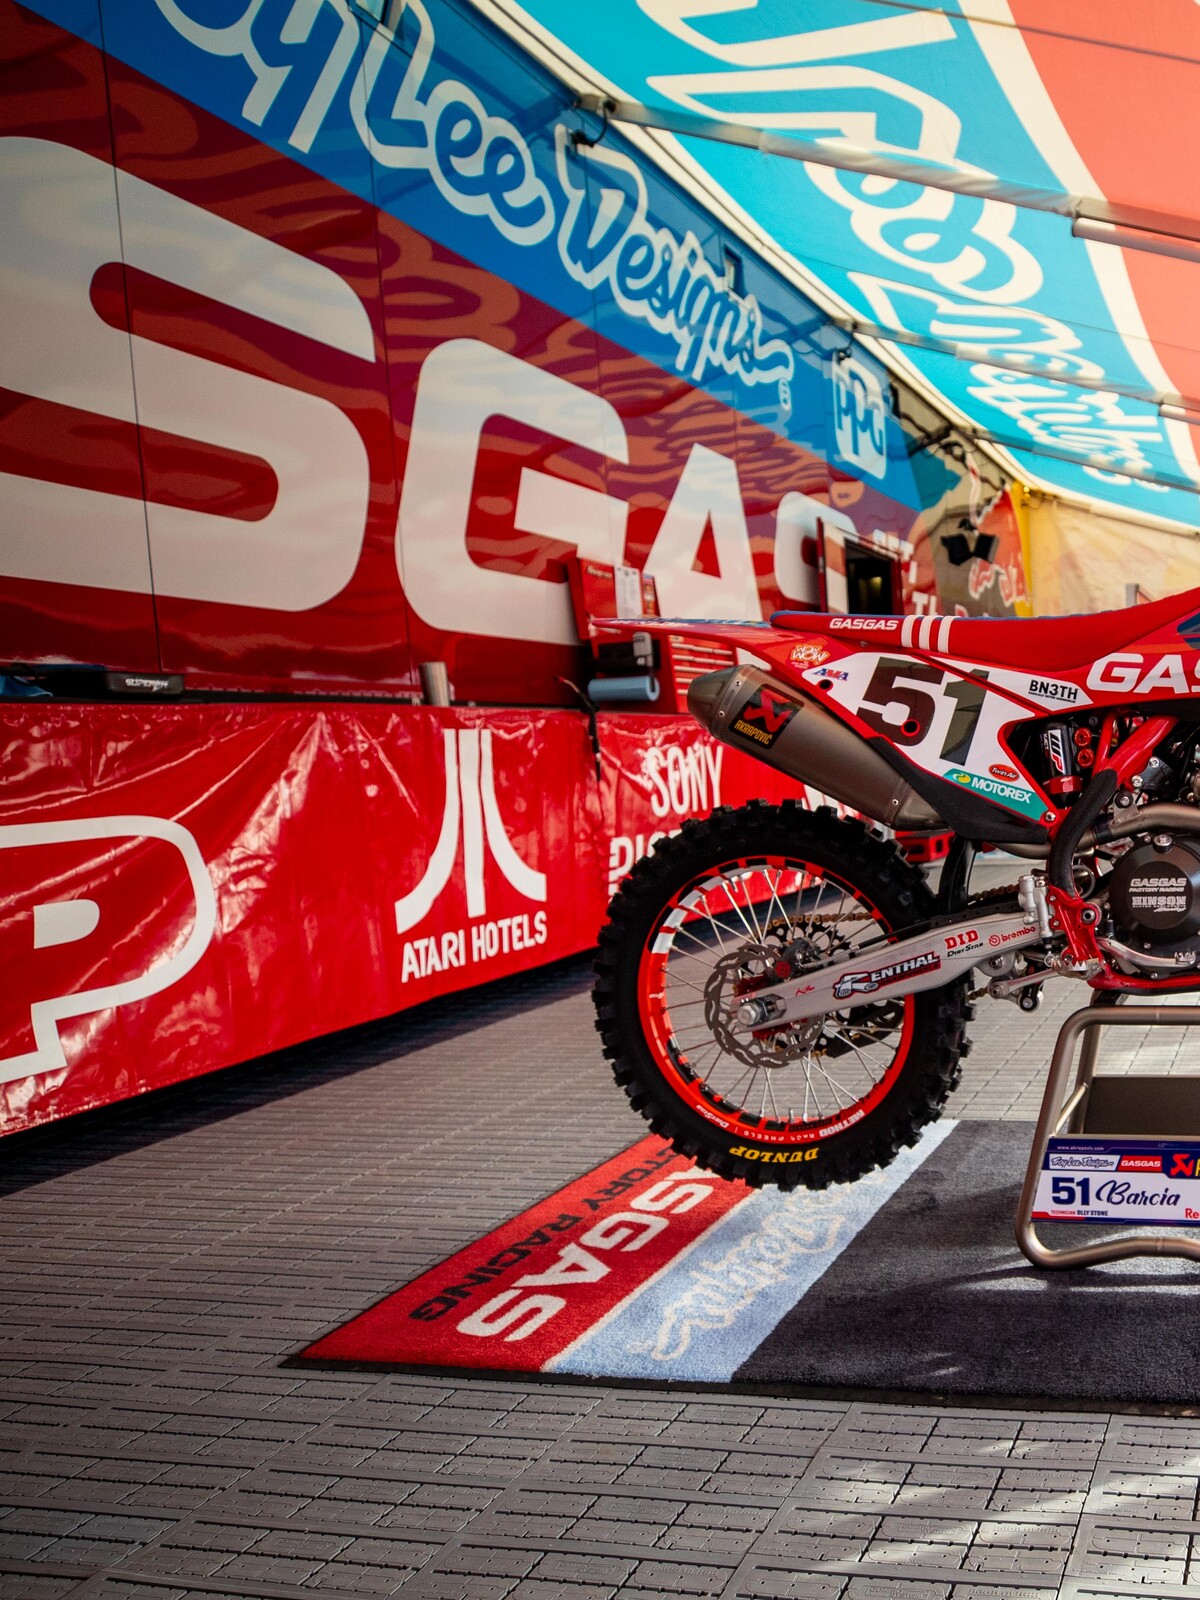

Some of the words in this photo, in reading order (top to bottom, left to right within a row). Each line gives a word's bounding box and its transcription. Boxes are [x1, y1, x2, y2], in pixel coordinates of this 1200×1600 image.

[829, 617, 899, 631] GASGAS
[813, 668, 849, 681] AMA
[1029, 679, 1078, 700] BN3TH
[856, 656, 990, 767] 51
[646, 743, 724, 817] SONY
[991, 766, 1007, 777] Twin
[1005, 770, 1018, 779] Air
[971, 776, 1032, 804] MOTOREX
[1130, 877, 1187, 887] GASGAS
[1132, 895, 1187, 906] HINSON
[1002, 926, 1037, 942] brembo
[401, 928, 466, 983] ATARI
[471, 910, 548, 963] HOTELS
[834, 952, 941, 999] RENTHAL
[819, 1109, 866, 1137] METHOD
[729, 1145, 820, 1164] DUNLOP
[1051, 1156, 1067, 1168] Troy
[1065, 1157, 1083, 1167] Lee
[1081, 1156, 1115, 1169] Designs
[1121, 1159, 1161, 1168] GASGAS
[1052, 1176, 1090, 1206] 51
[1095, 1179, 1181, 1206] Barcia
[408, 1213, 584, 1324] RACING
